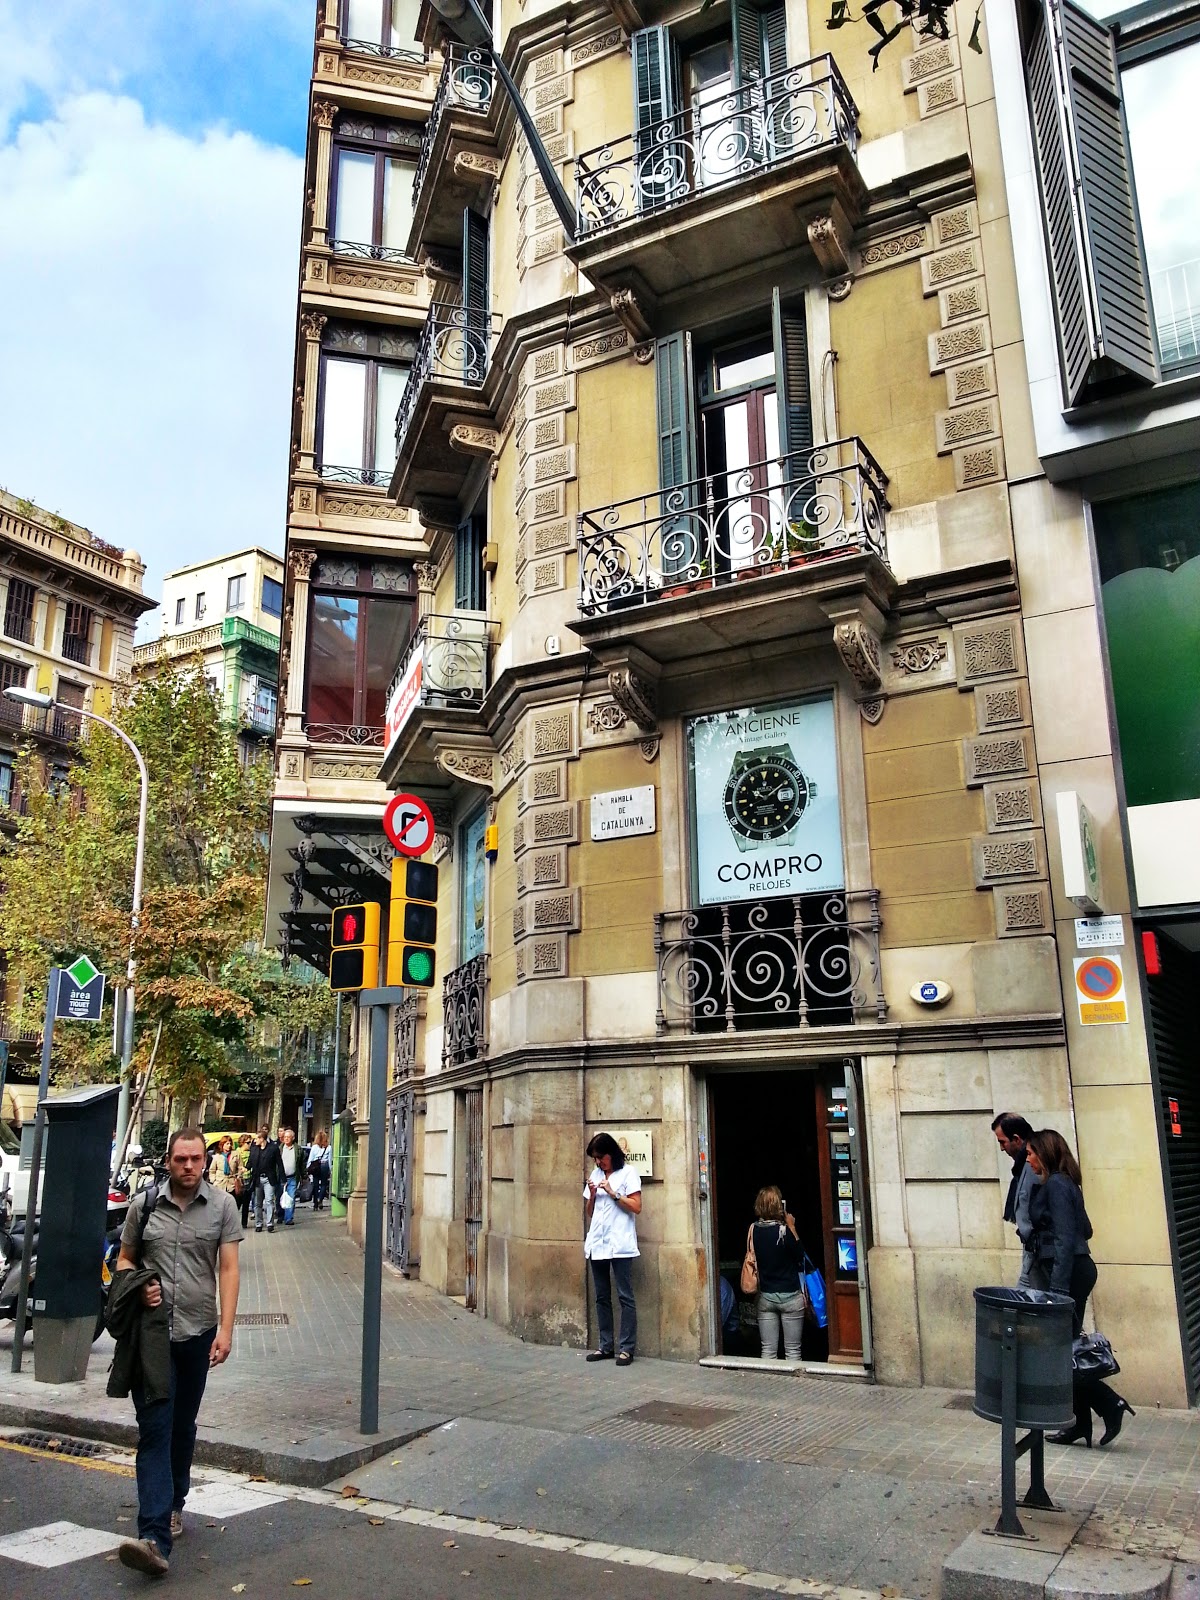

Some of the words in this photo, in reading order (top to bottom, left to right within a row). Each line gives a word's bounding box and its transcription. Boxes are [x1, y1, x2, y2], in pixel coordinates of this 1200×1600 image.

[725, 712, 801, 737] ANCIENNE
[739, 735, 763, 743] Vintage
[764, 731, 788, 740] Gallery
[610, 794, 633, 804] RAMBLA
[618, 806, 626, 815] DE
[601, 816, 644, 831] CATALUNYA
[717, 853, 823, 883] COMPRO
[749, 878, 791, 892] RELOJES
[70, 989, 91, 1000] àrea
[1084, 1012, 1123, 1022] PERMANENT
[305, 1099, 312, 1113] P
